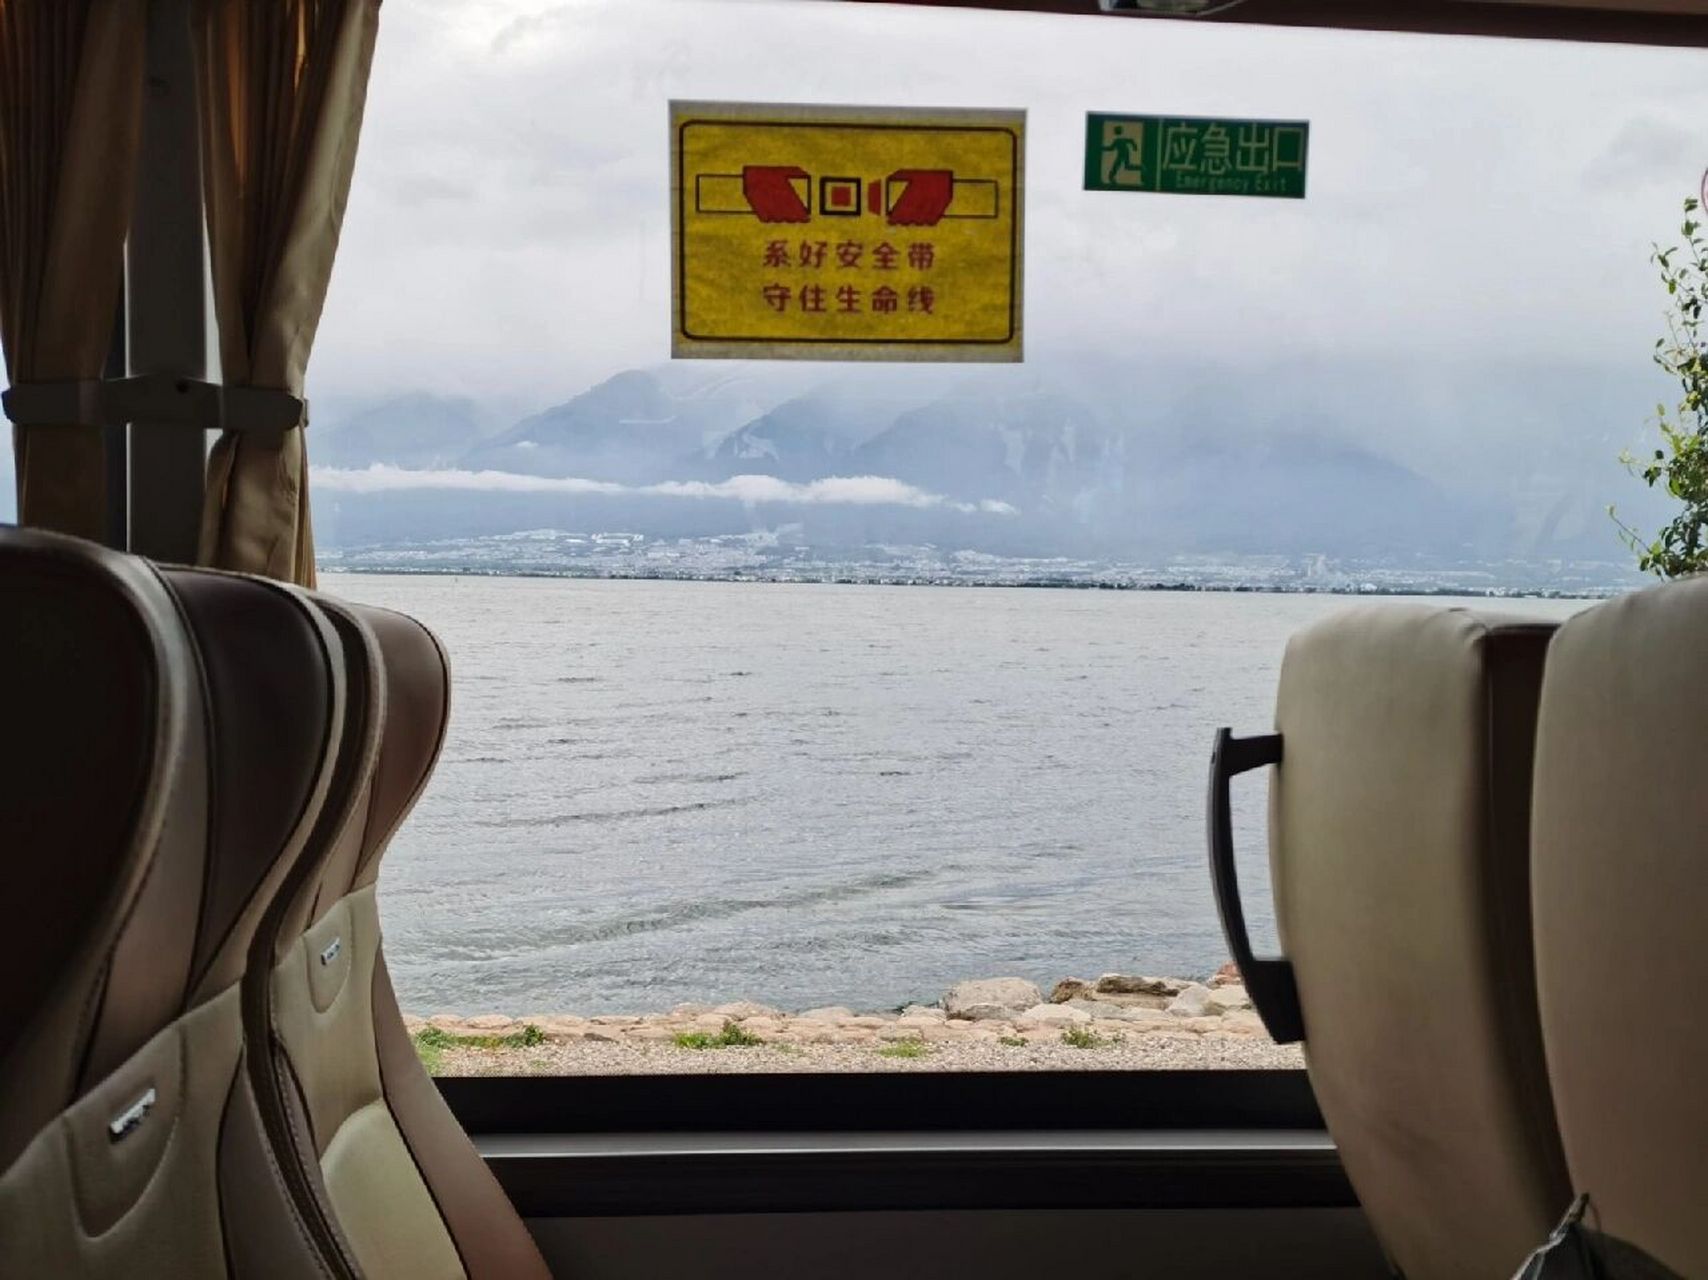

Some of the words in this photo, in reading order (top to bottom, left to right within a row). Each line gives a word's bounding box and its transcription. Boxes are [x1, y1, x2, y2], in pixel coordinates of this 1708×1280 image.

[1162, 122, 1304, 175] 应急出口
[1176, 173, 1250, 192] Emergency
[1255, 175, 1287, 192] Exit
[762, 240, 936, 271] 系好安全带
[762, 283, 935, 315] 守住生命线
